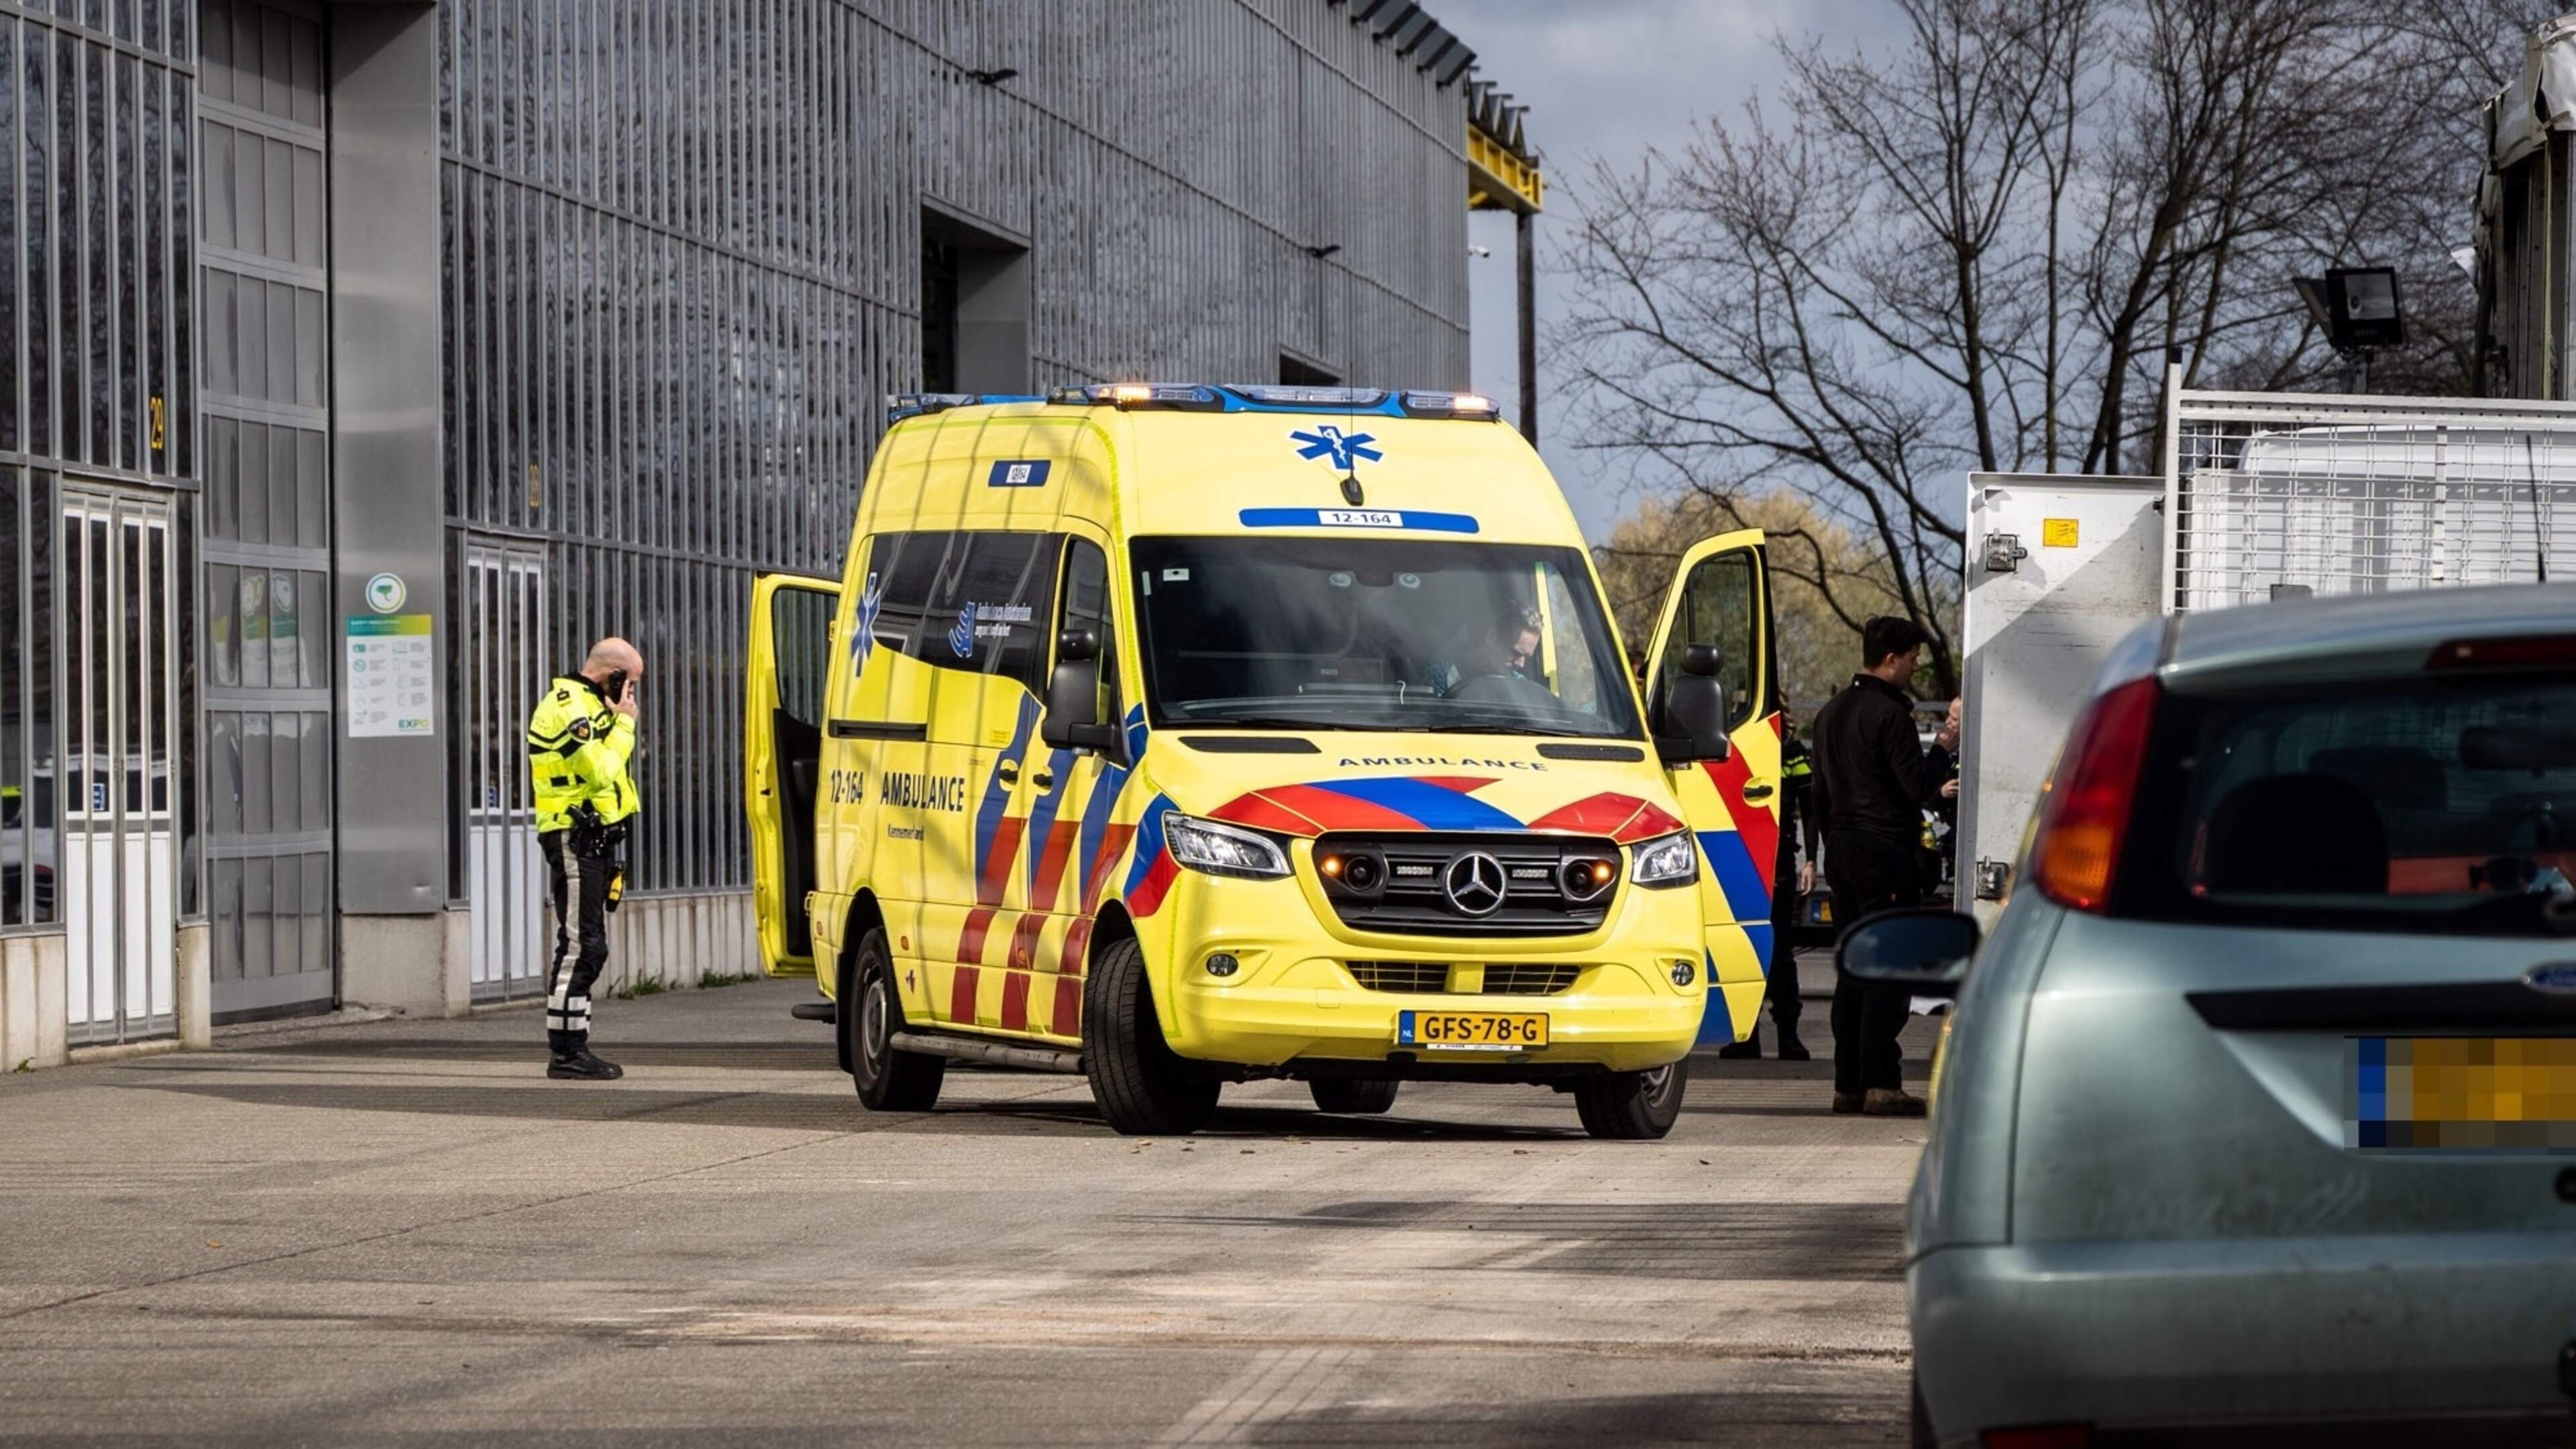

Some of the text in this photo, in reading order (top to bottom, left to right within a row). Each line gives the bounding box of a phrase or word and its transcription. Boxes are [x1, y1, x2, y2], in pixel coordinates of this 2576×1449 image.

[150, 396, 163, 449] 29
[1332, 513, 1391, 524] 12-164
[398, 718, 430, 729] EXPO
[1338, 757, 1548, 771] AMBULANCE
[830, 769, 965, 812] 12-164 AMBULANCE
[1402, 1016, 1538, 1041] NL GFS-78-G
